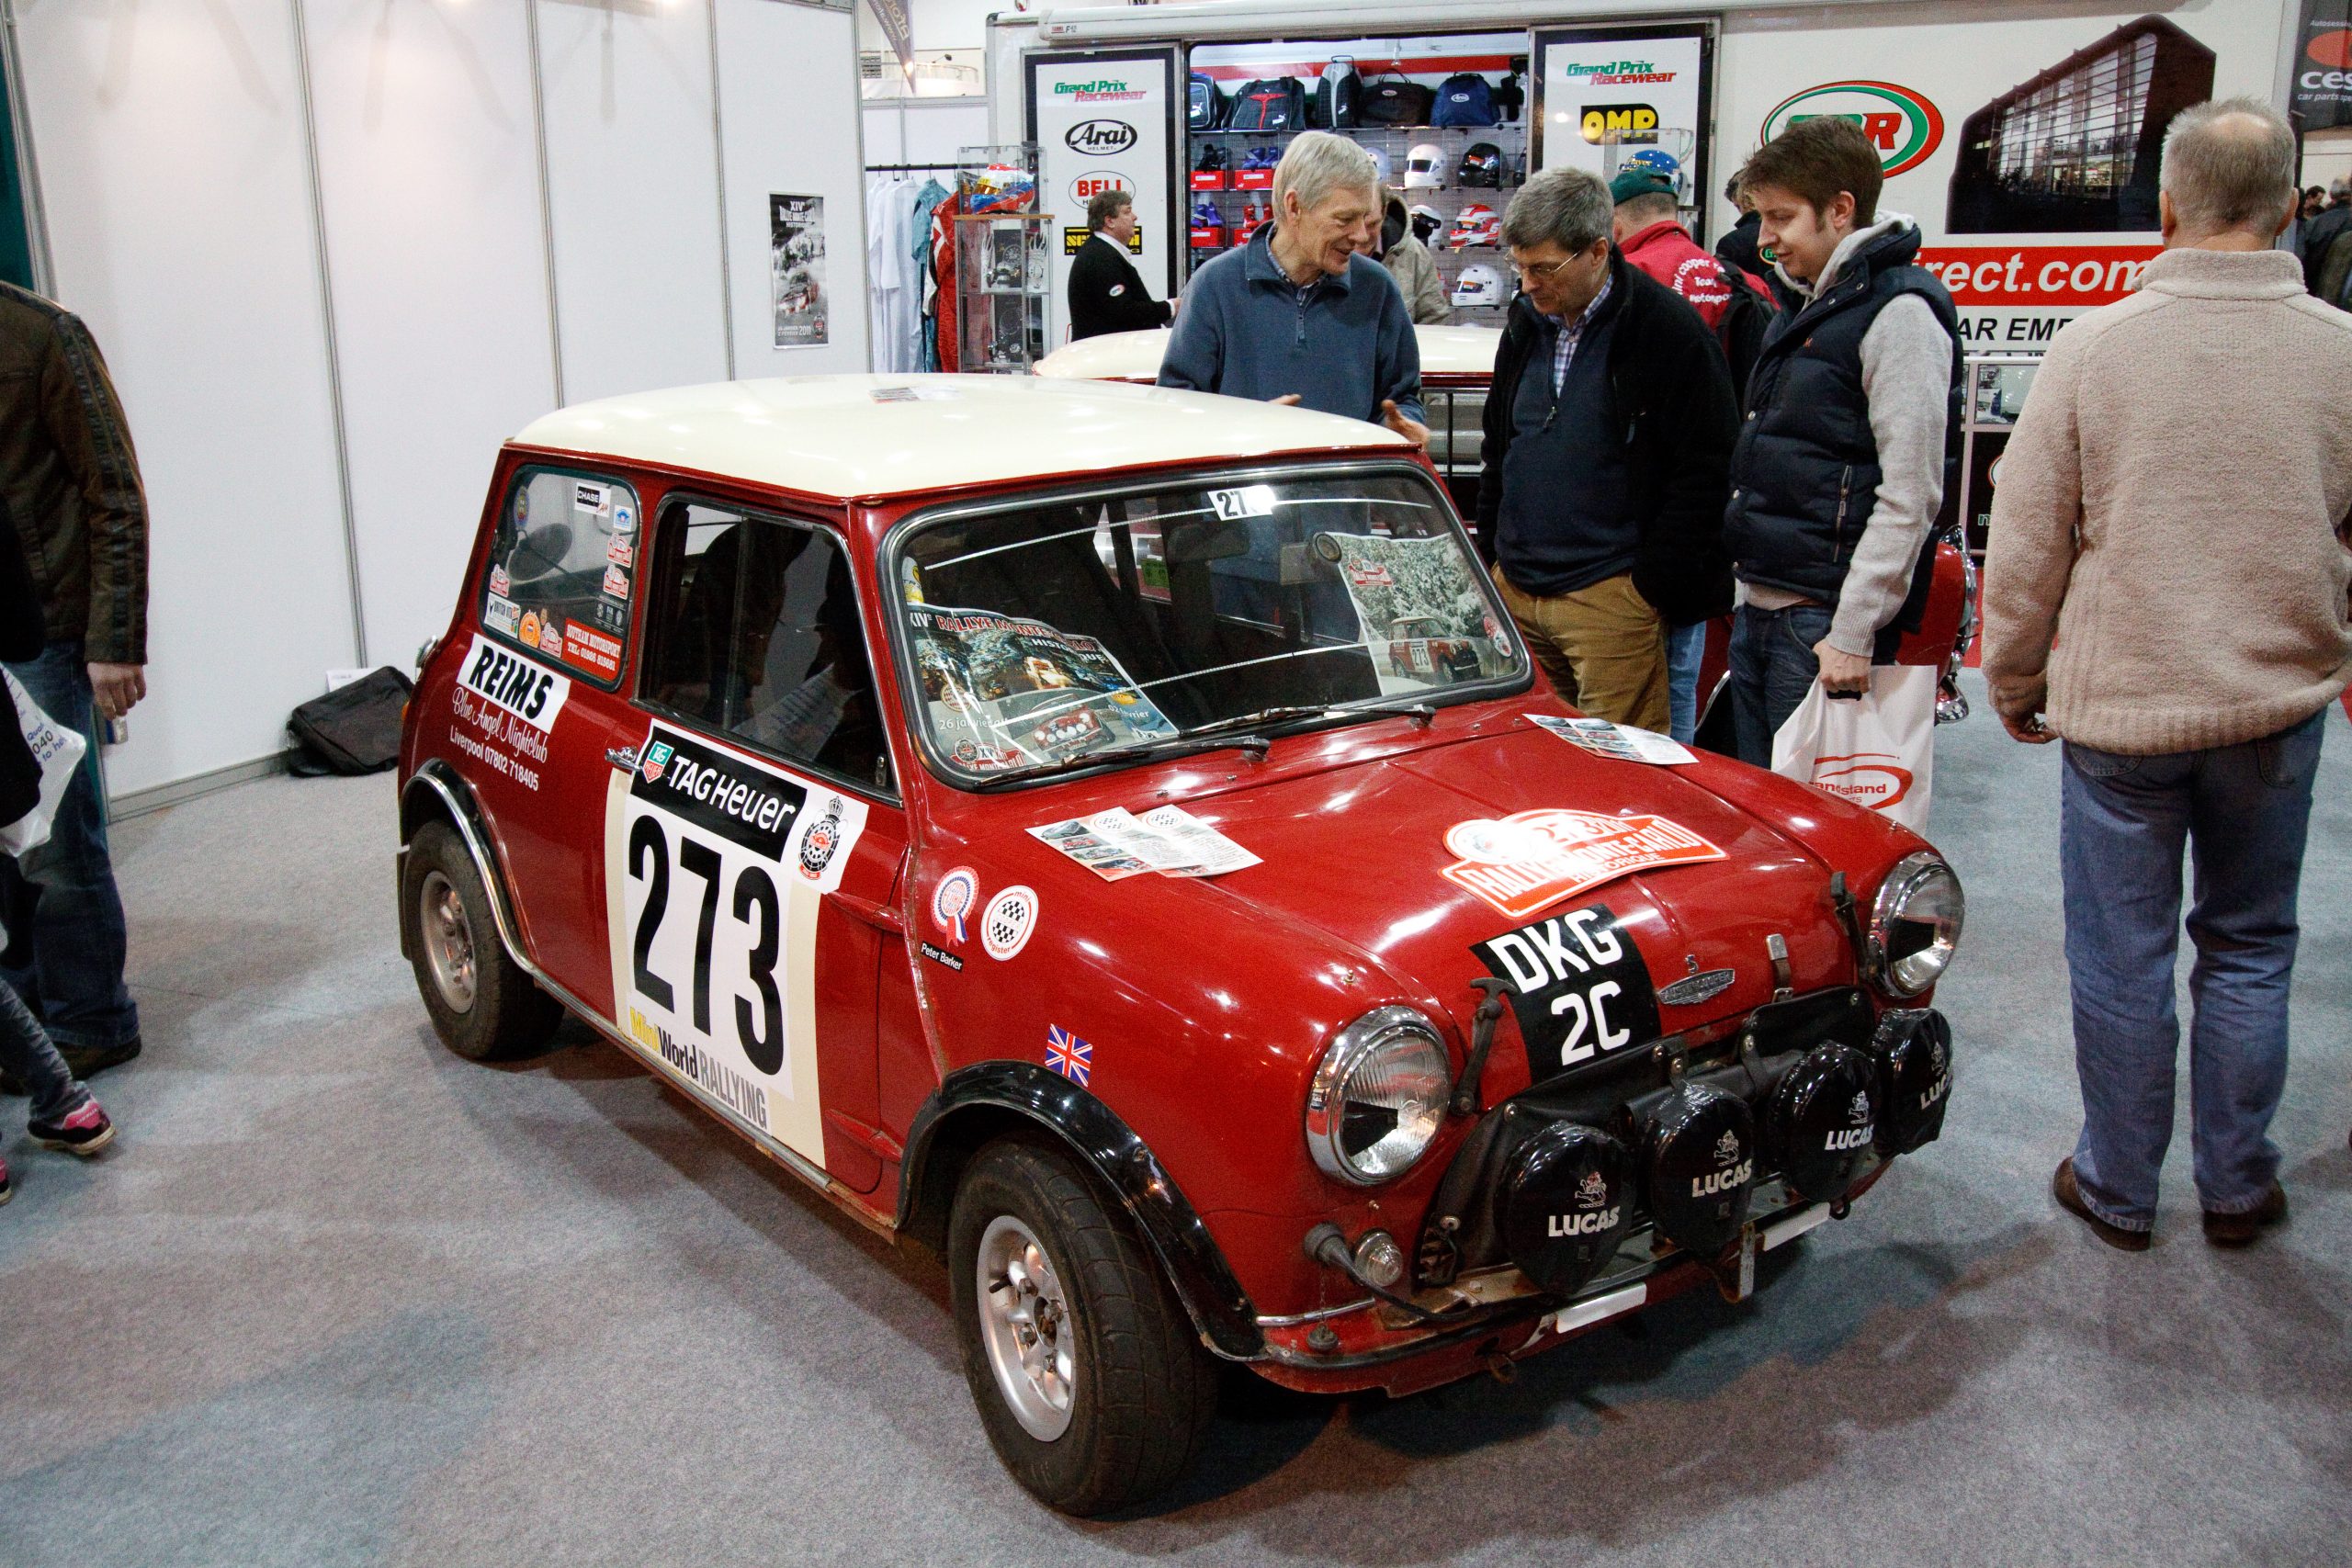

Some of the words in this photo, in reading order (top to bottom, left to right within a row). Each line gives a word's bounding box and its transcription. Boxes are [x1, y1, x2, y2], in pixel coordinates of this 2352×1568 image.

[1566, 62, 1617, 76] Grand
[1618, 61, 1655, 74] Prix
[1589, 72, 1677, 85] Racewear
[1055, 80, 1096, 94] Grand
[1097, 80, 1127, 92] Prix
[1074, 91, 1147, 102] Racewear
[2314, 93, 2339, 102] parts
[1069, 123, 1128, 146] Arai
[1583, 108, 1657, 140] OMP
[1679, 258, 1711, 276] cooper
[1957, 318, 1998, 341] AR
[577, 491, 599, 503] CHASE
[935, 615, 993, 632] RALLYE
[468, 644, 554, 720] REIMS
[452, 686, 473, 721] Blue
[471, 700, 504, 741] Angel
[500, 716, 548, 764] Nightclub
[32, 730, 53, 754] 040
[449, 725, 483, 760] Liverpool
[484, 745, 508, 774] 07802
[509, 759, 539, 792] 718405
[1014, 890, 1031, 903] mini
[628, 814, 785, 1077] 273
[921, 942, 940, 959] Peter
[939, 952, 963, 971] Barker
[987, 937, 1011, 954] register
[1485, 908, 1623, 994] DKG
[1550, 980, 1631, 1066] 2C
[698, 1048, 769, 1130] RALLYING
[1825, 1123, 1874, 1151] LUCAS
[1691, 1158, 1752, 1198] LUCAS
[1548, 1205, 1621, 1237] LUCAS
